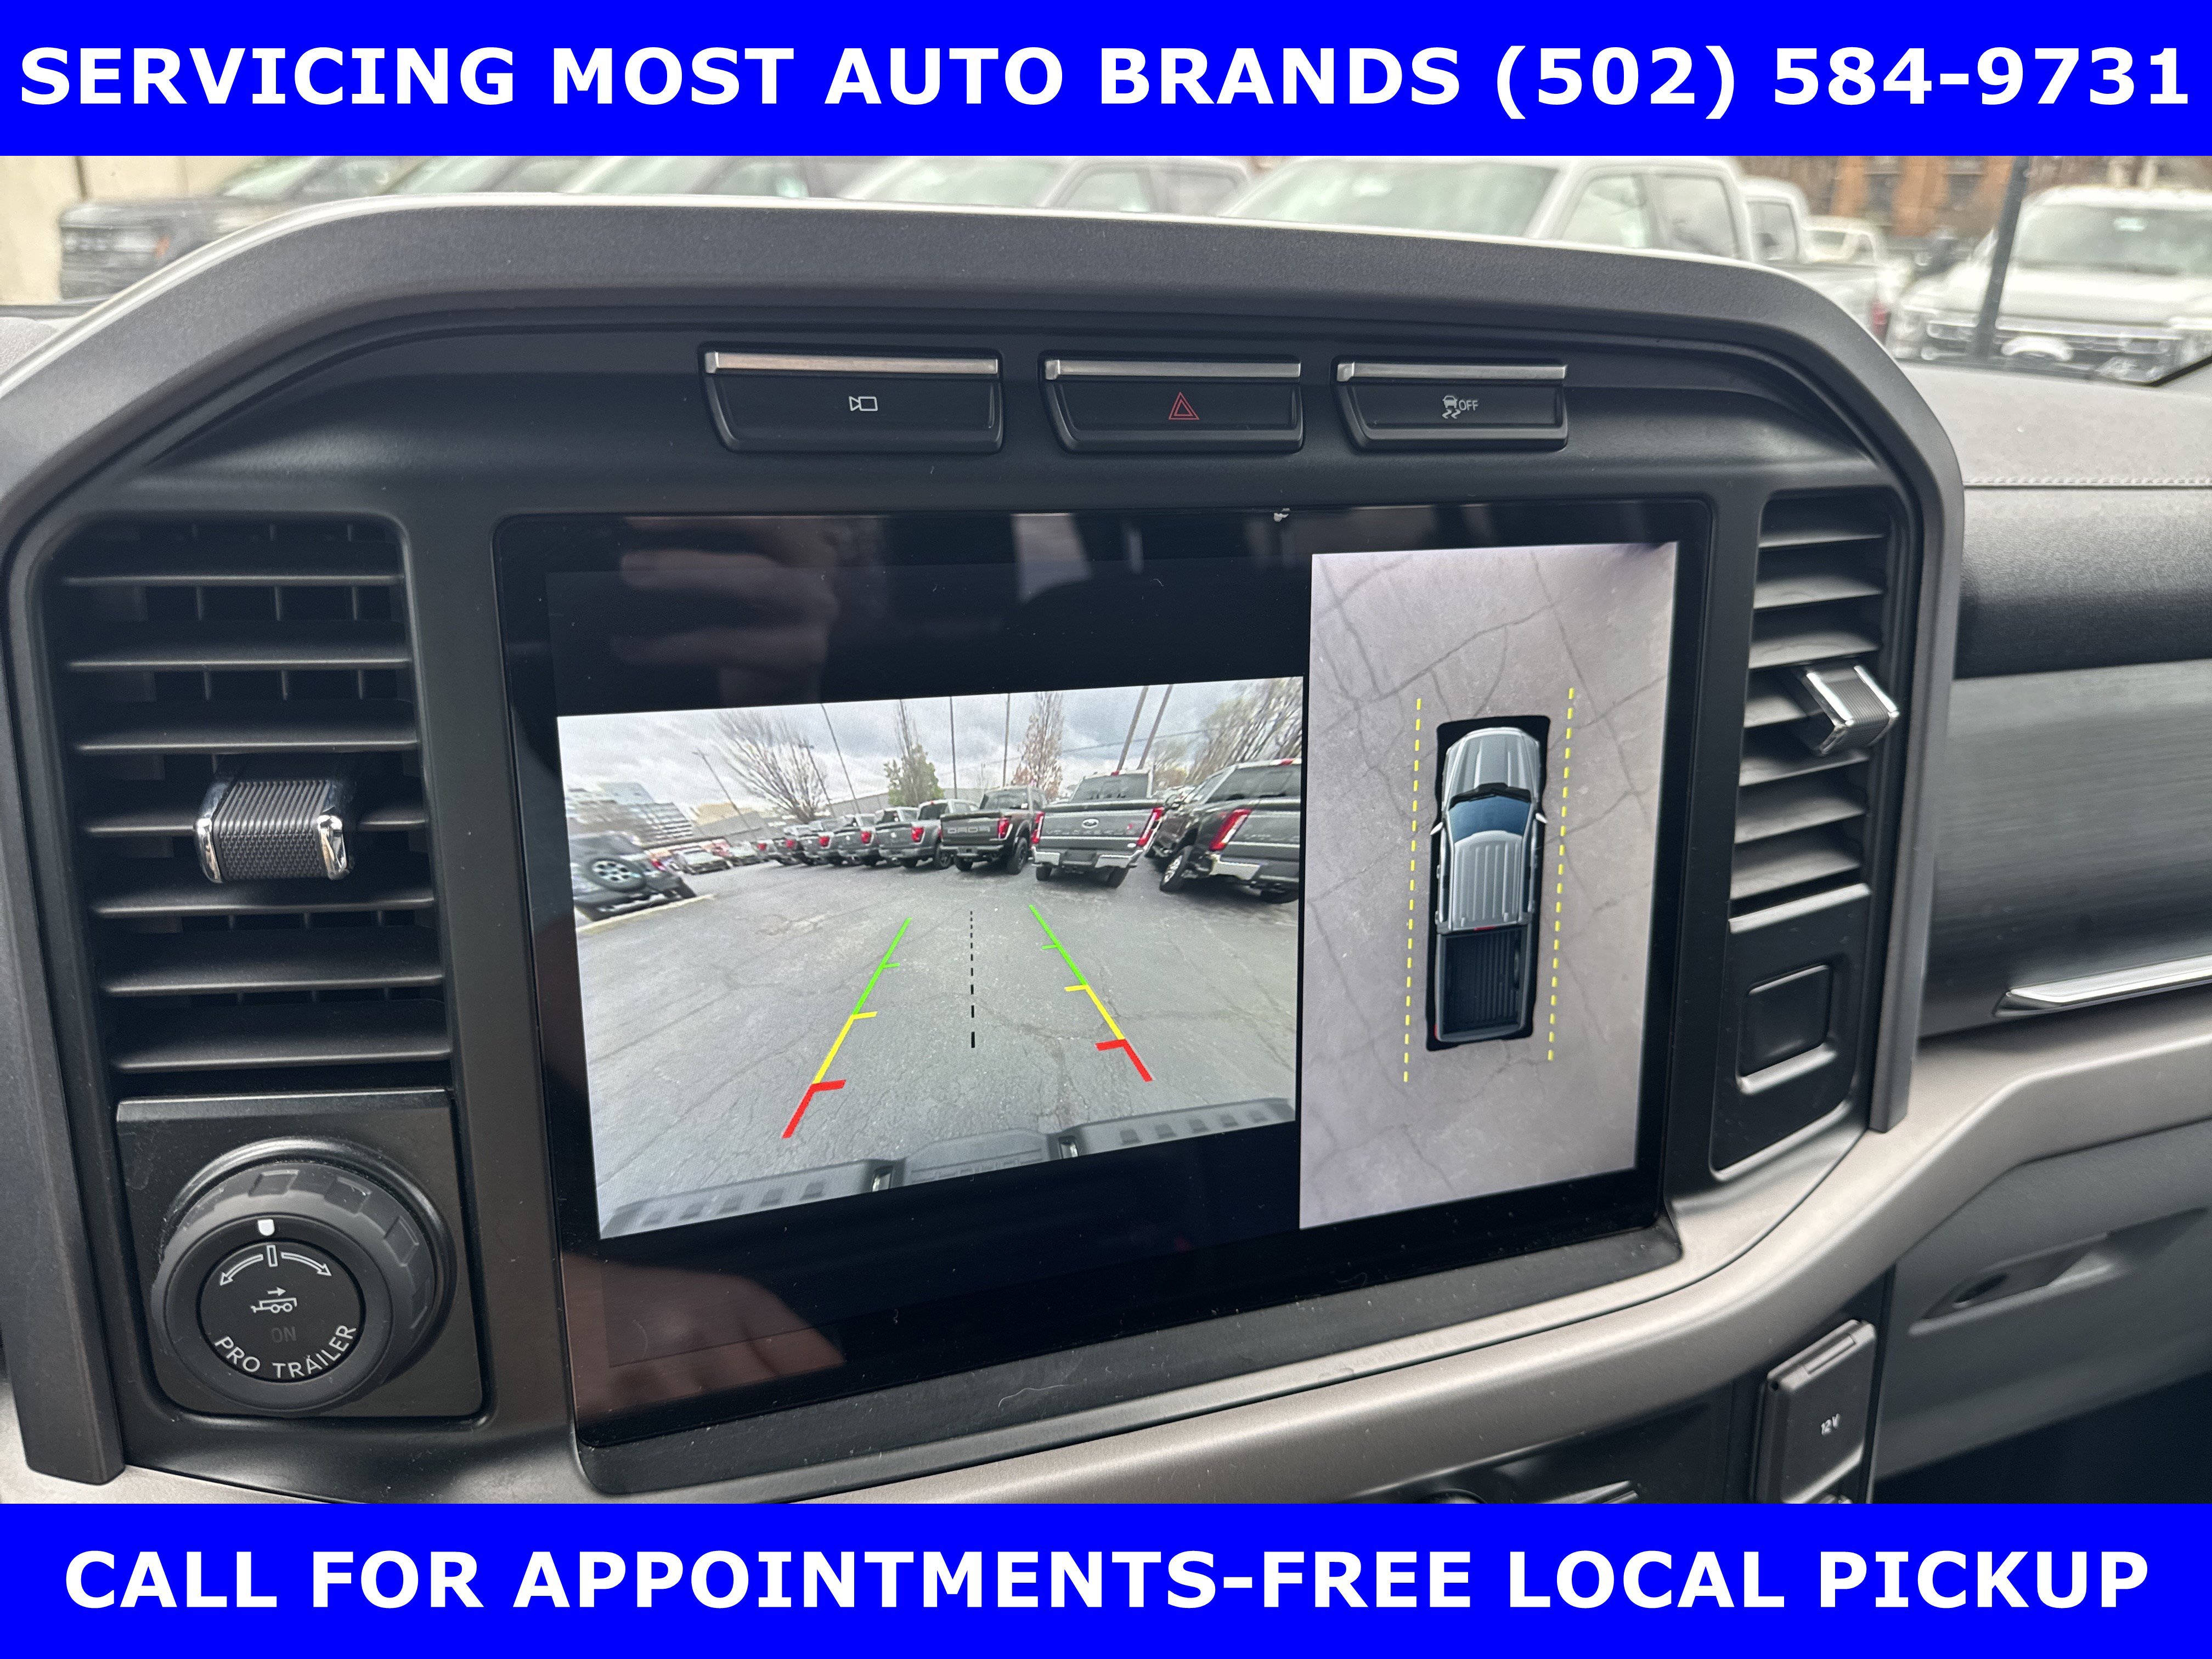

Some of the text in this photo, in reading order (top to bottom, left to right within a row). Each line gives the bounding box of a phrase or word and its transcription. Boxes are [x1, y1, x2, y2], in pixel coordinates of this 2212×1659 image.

[1458, 400, 1479, 411] OFF
[272, 1326, 297, 1343] ON
[215, 1324, 357, 1379] PRO TRAILER
